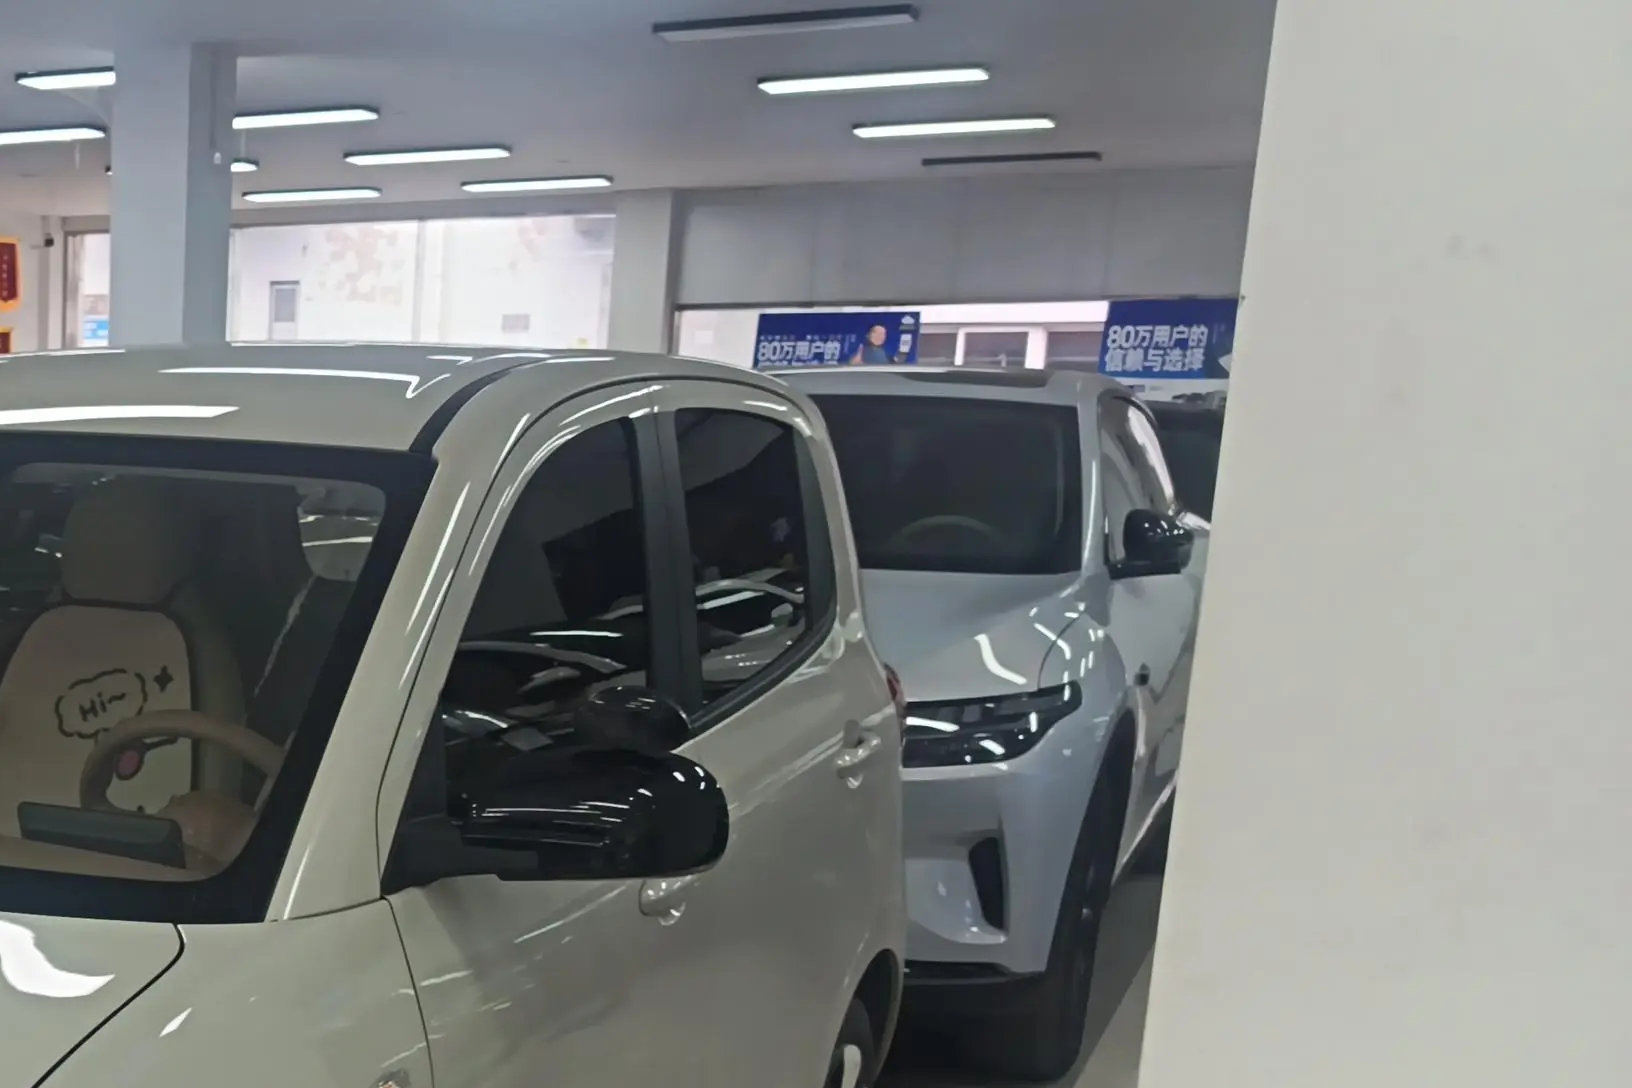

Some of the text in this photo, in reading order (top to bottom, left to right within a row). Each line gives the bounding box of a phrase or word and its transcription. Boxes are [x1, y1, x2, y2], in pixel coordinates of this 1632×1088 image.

[1107, 324, 1208, 348] 80万用户的
[758, 340, 841, 360] 80万用户的
